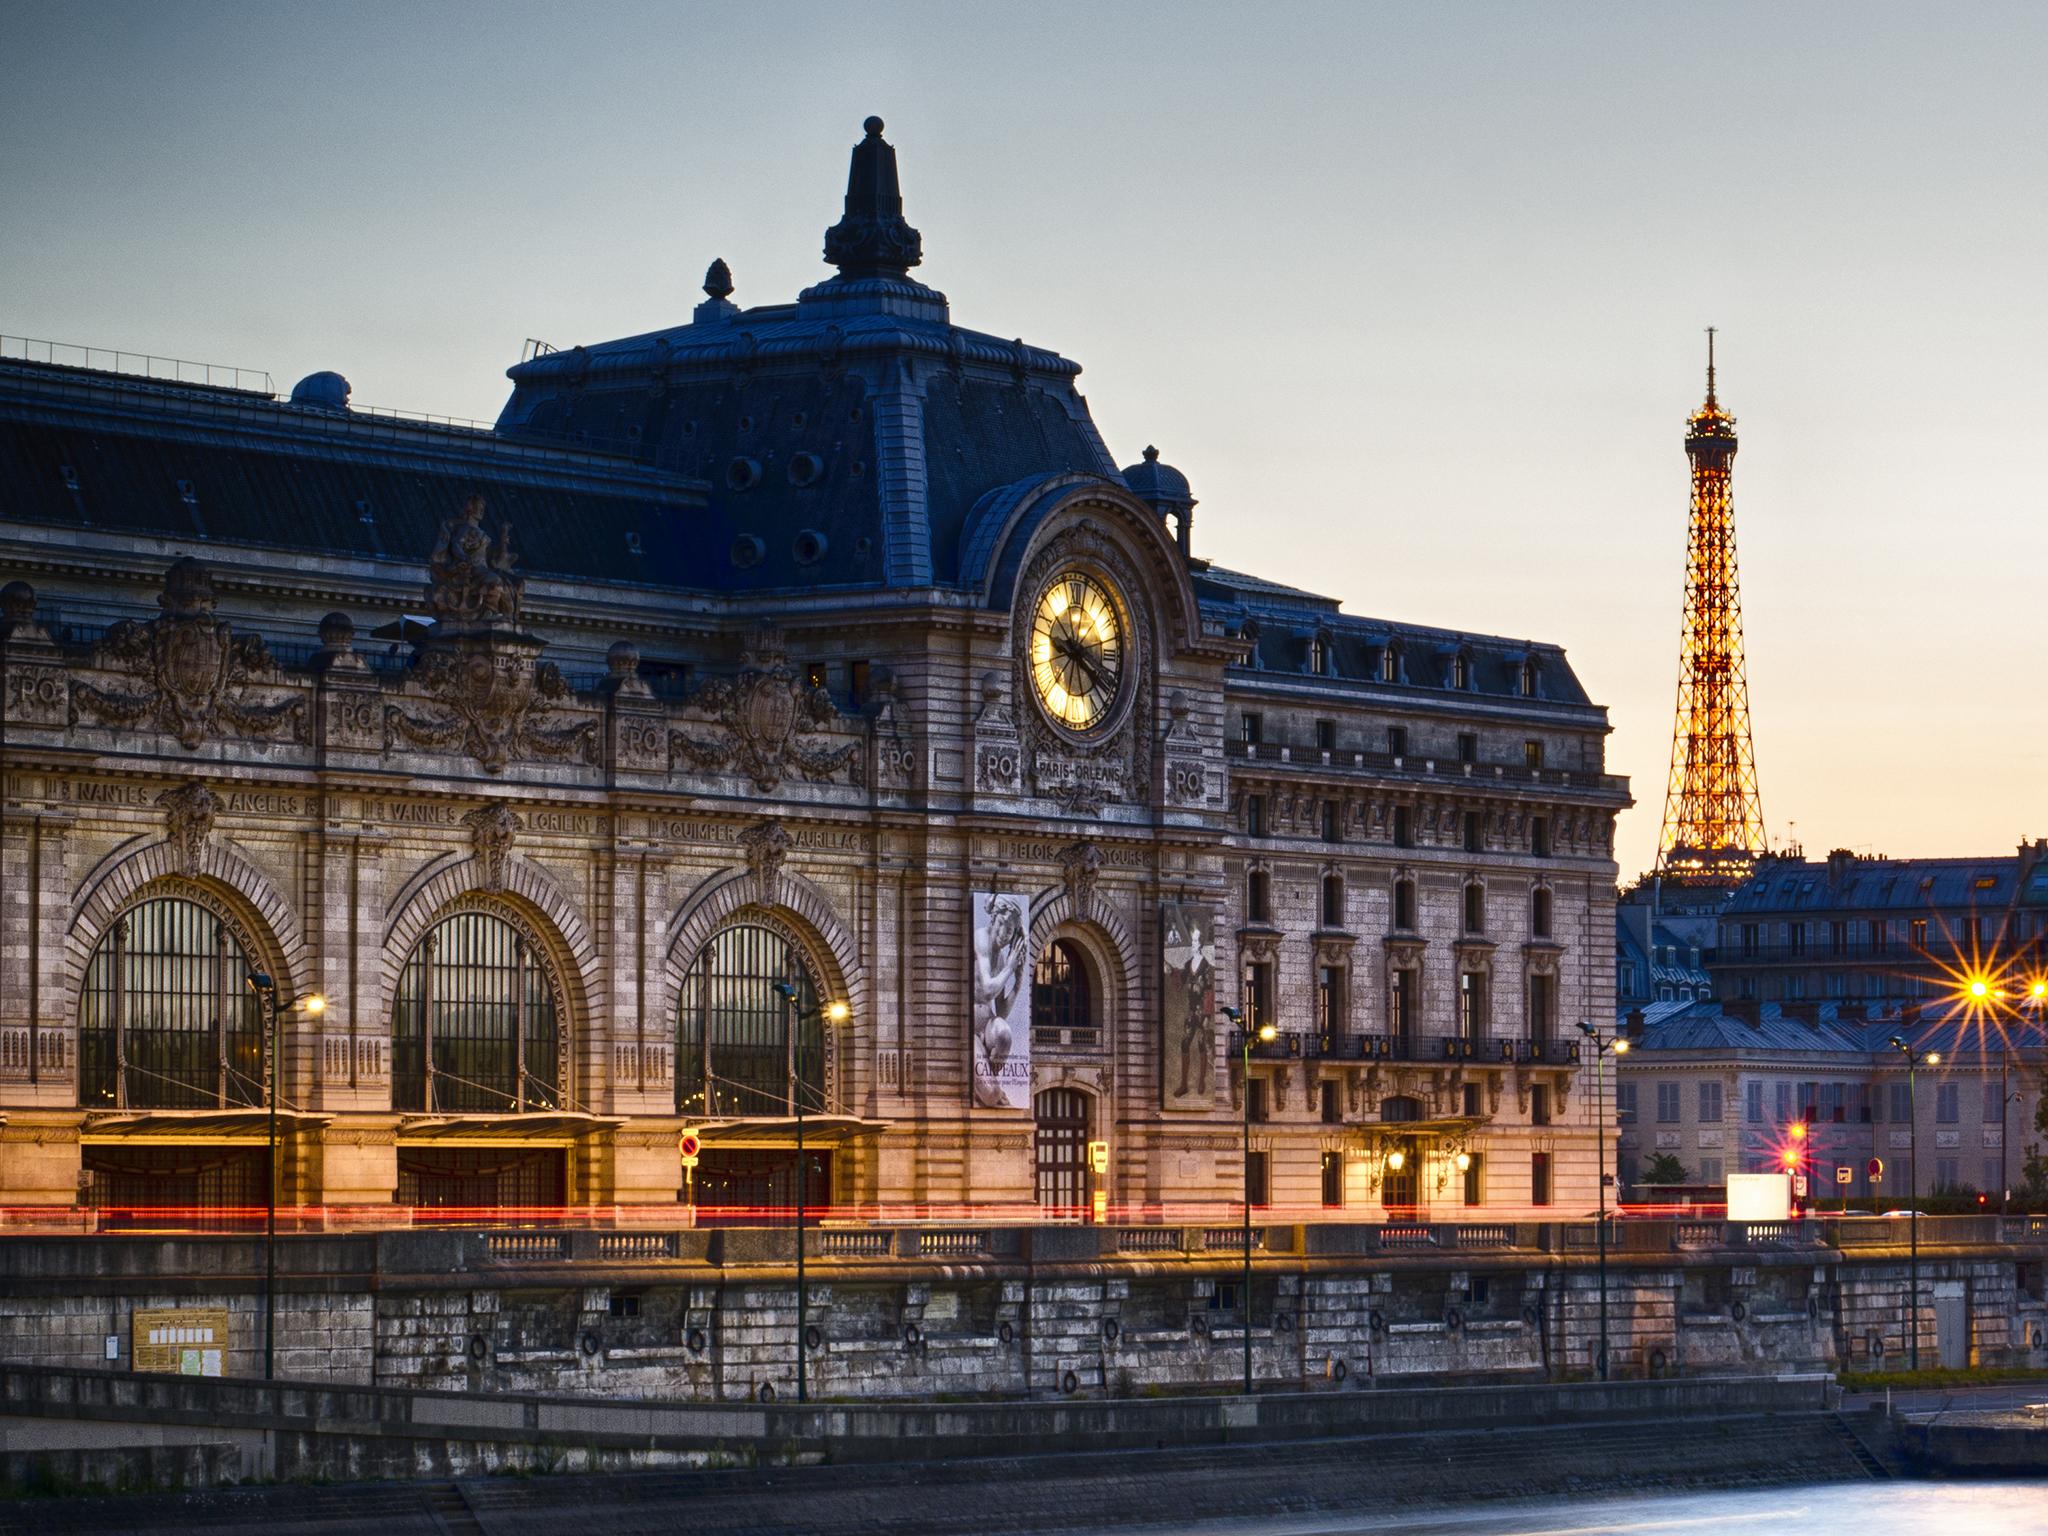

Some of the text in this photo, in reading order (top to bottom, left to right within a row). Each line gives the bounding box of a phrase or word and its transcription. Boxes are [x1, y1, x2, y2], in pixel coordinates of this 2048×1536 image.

[1068, 582, 1082, 605] XII
[1103, 648, 1116, 662] III
[78, 781, 149, 805] NANTES
[229, 793, 299, 814] ANGERS
[390, 802, 455, 823] VANNES
[527, 812, 593, 833] LORIENT
[671, 821, 737, 843] QUIMPER
[795, 830, 860, 850] AURILLAC
[1016, 843, 1055, 860] BLOIS
[975, 1061, 1029, 1077] CARPEAUX
